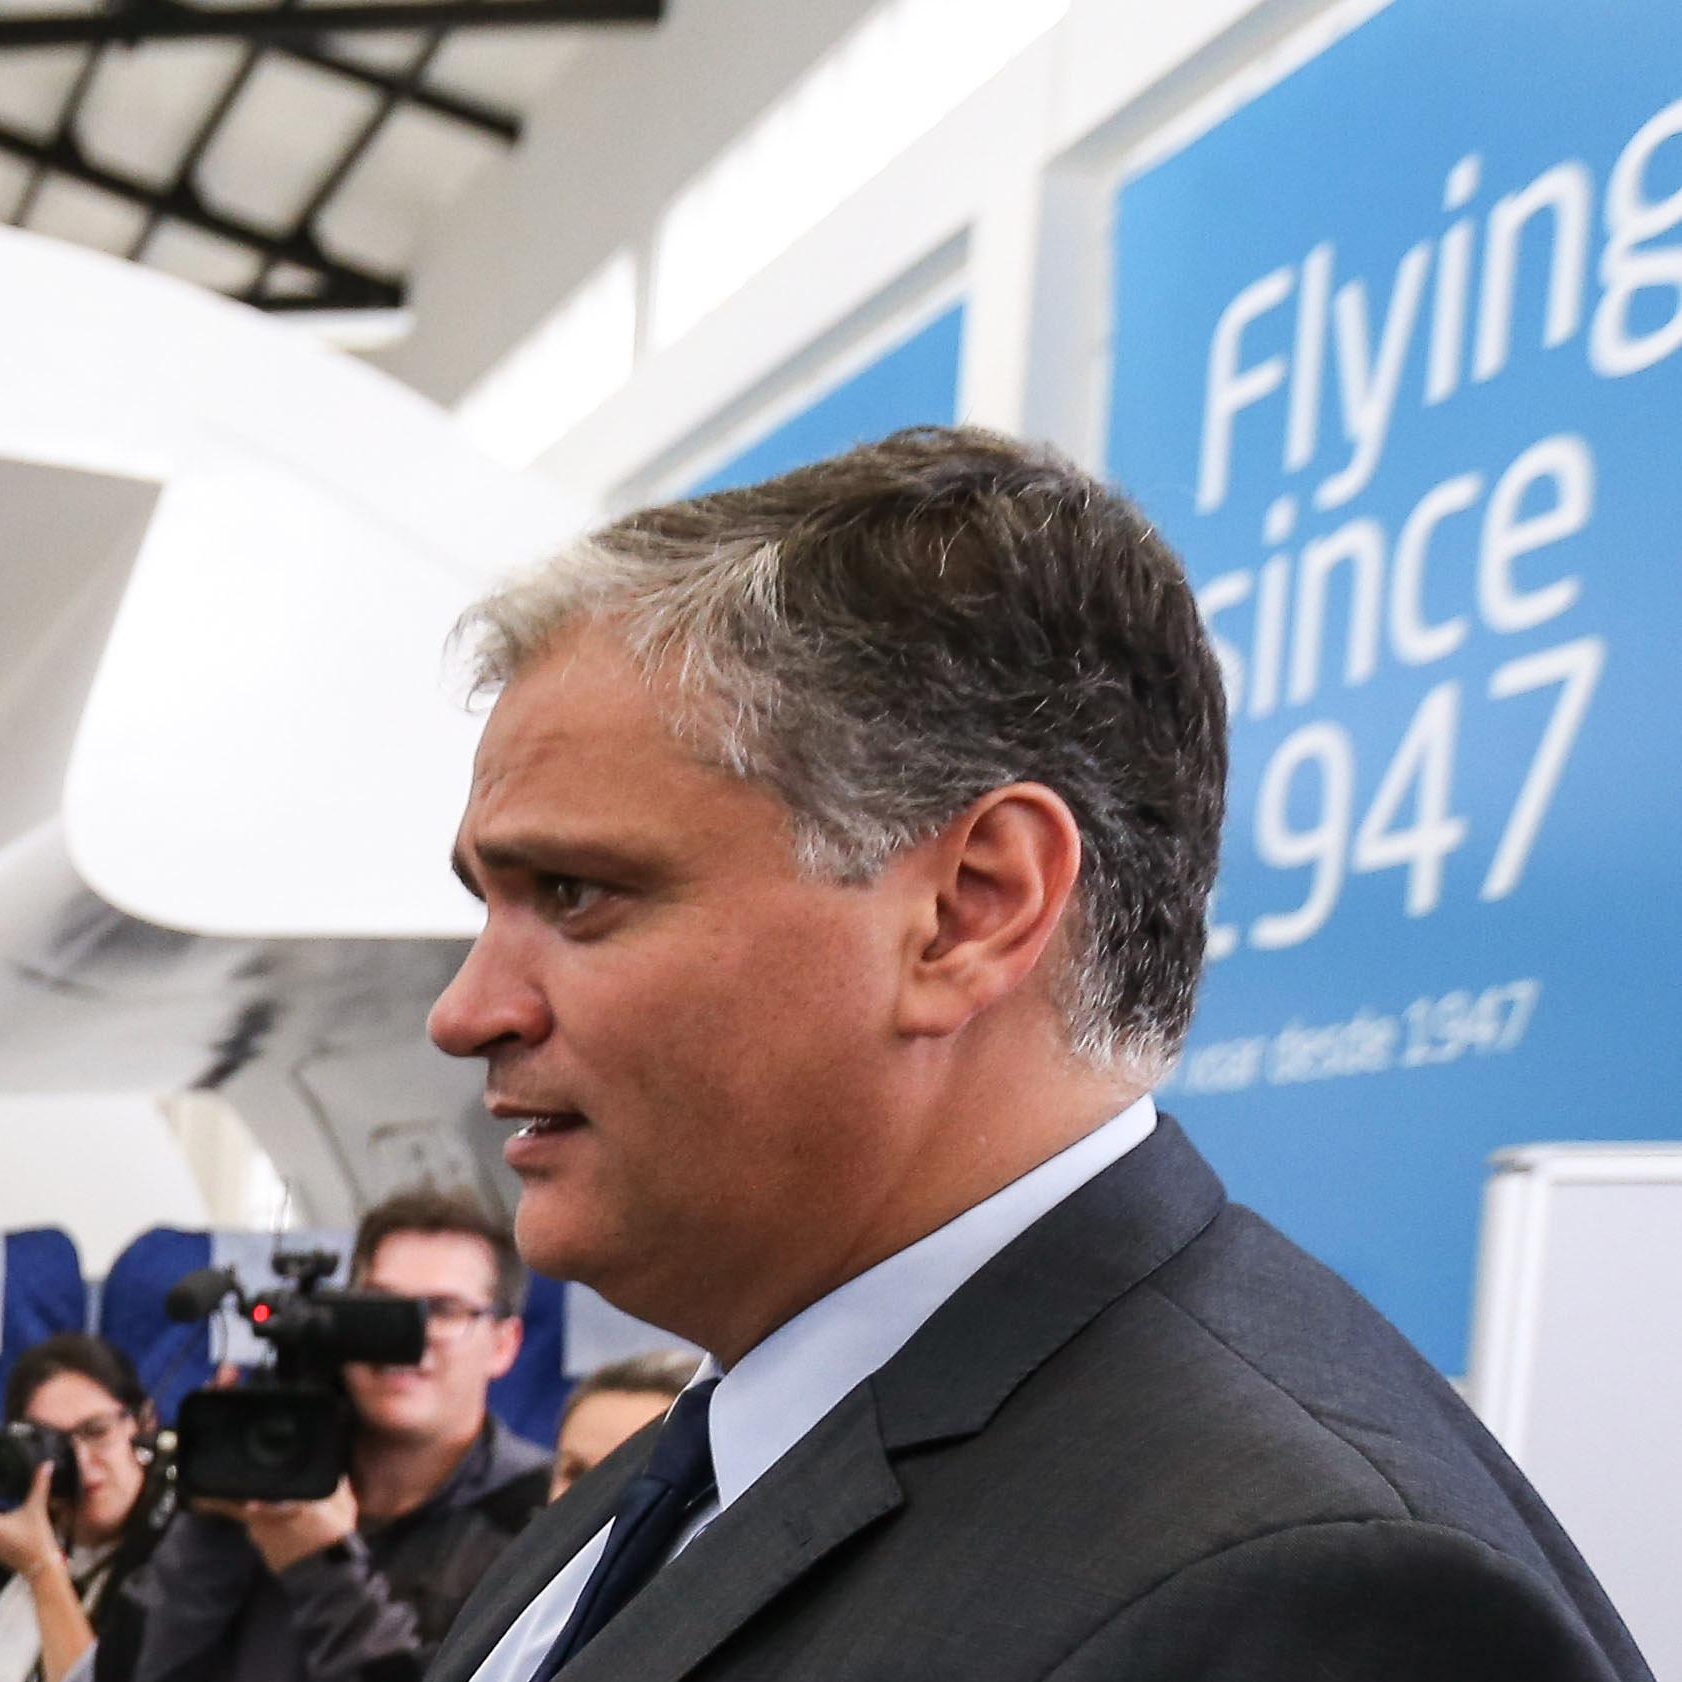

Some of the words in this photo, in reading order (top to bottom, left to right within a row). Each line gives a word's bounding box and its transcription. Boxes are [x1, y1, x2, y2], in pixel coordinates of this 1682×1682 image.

[1195, 98, 1682, 513] Flying
[1204, 636, 1605, 961] 947
[1403, 977, 1541, 1066] 1947
